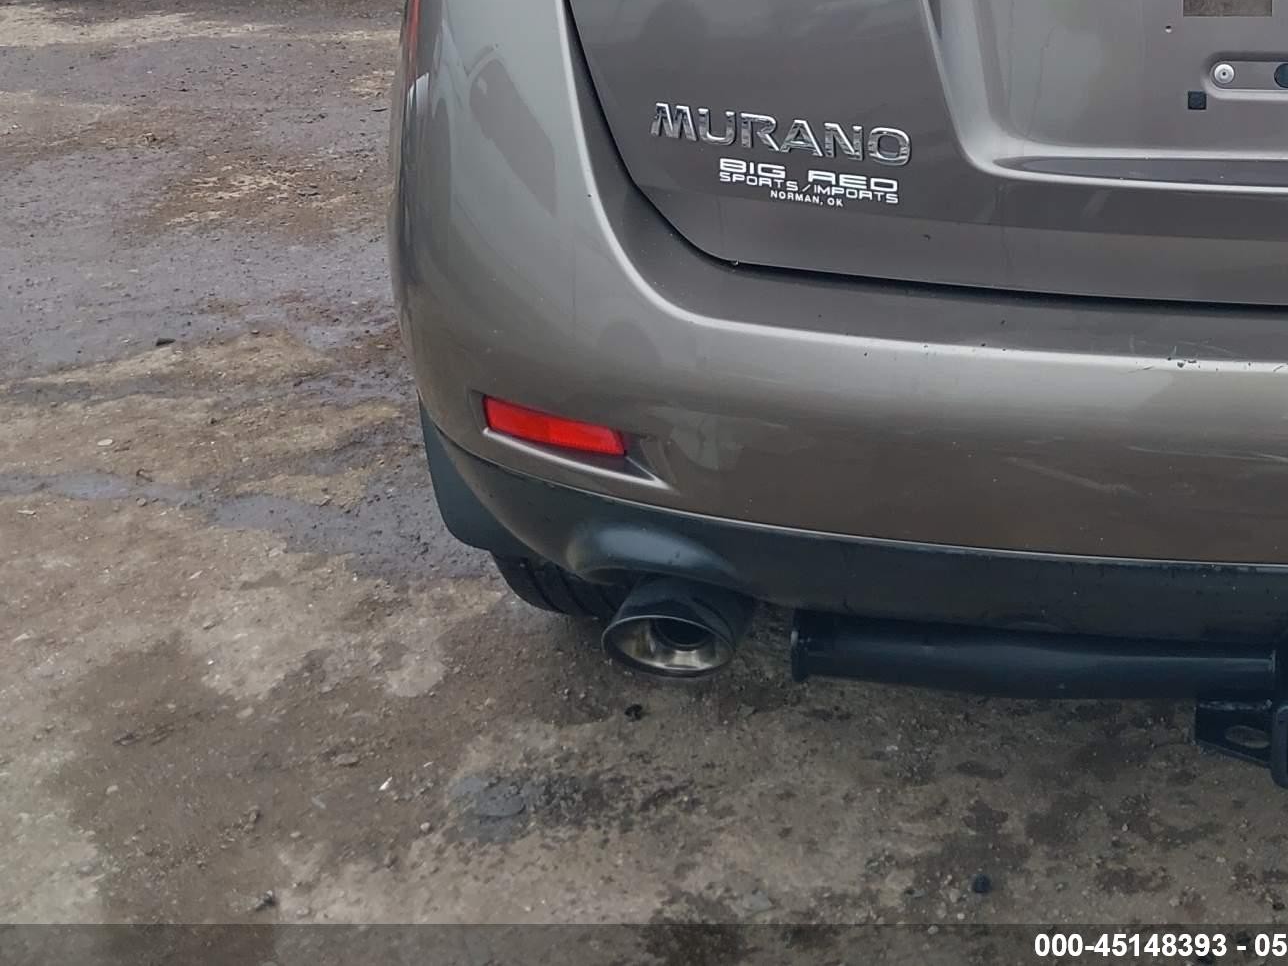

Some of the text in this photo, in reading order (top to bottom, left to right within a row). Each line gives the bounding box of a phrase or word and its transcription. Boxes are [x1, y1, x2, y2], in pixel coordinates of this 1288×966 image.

[650, 102, 911, 166] MURANO
[719, 158, 786, 179] BIG
[770, 190, 843, 207] NORMAN, OK
